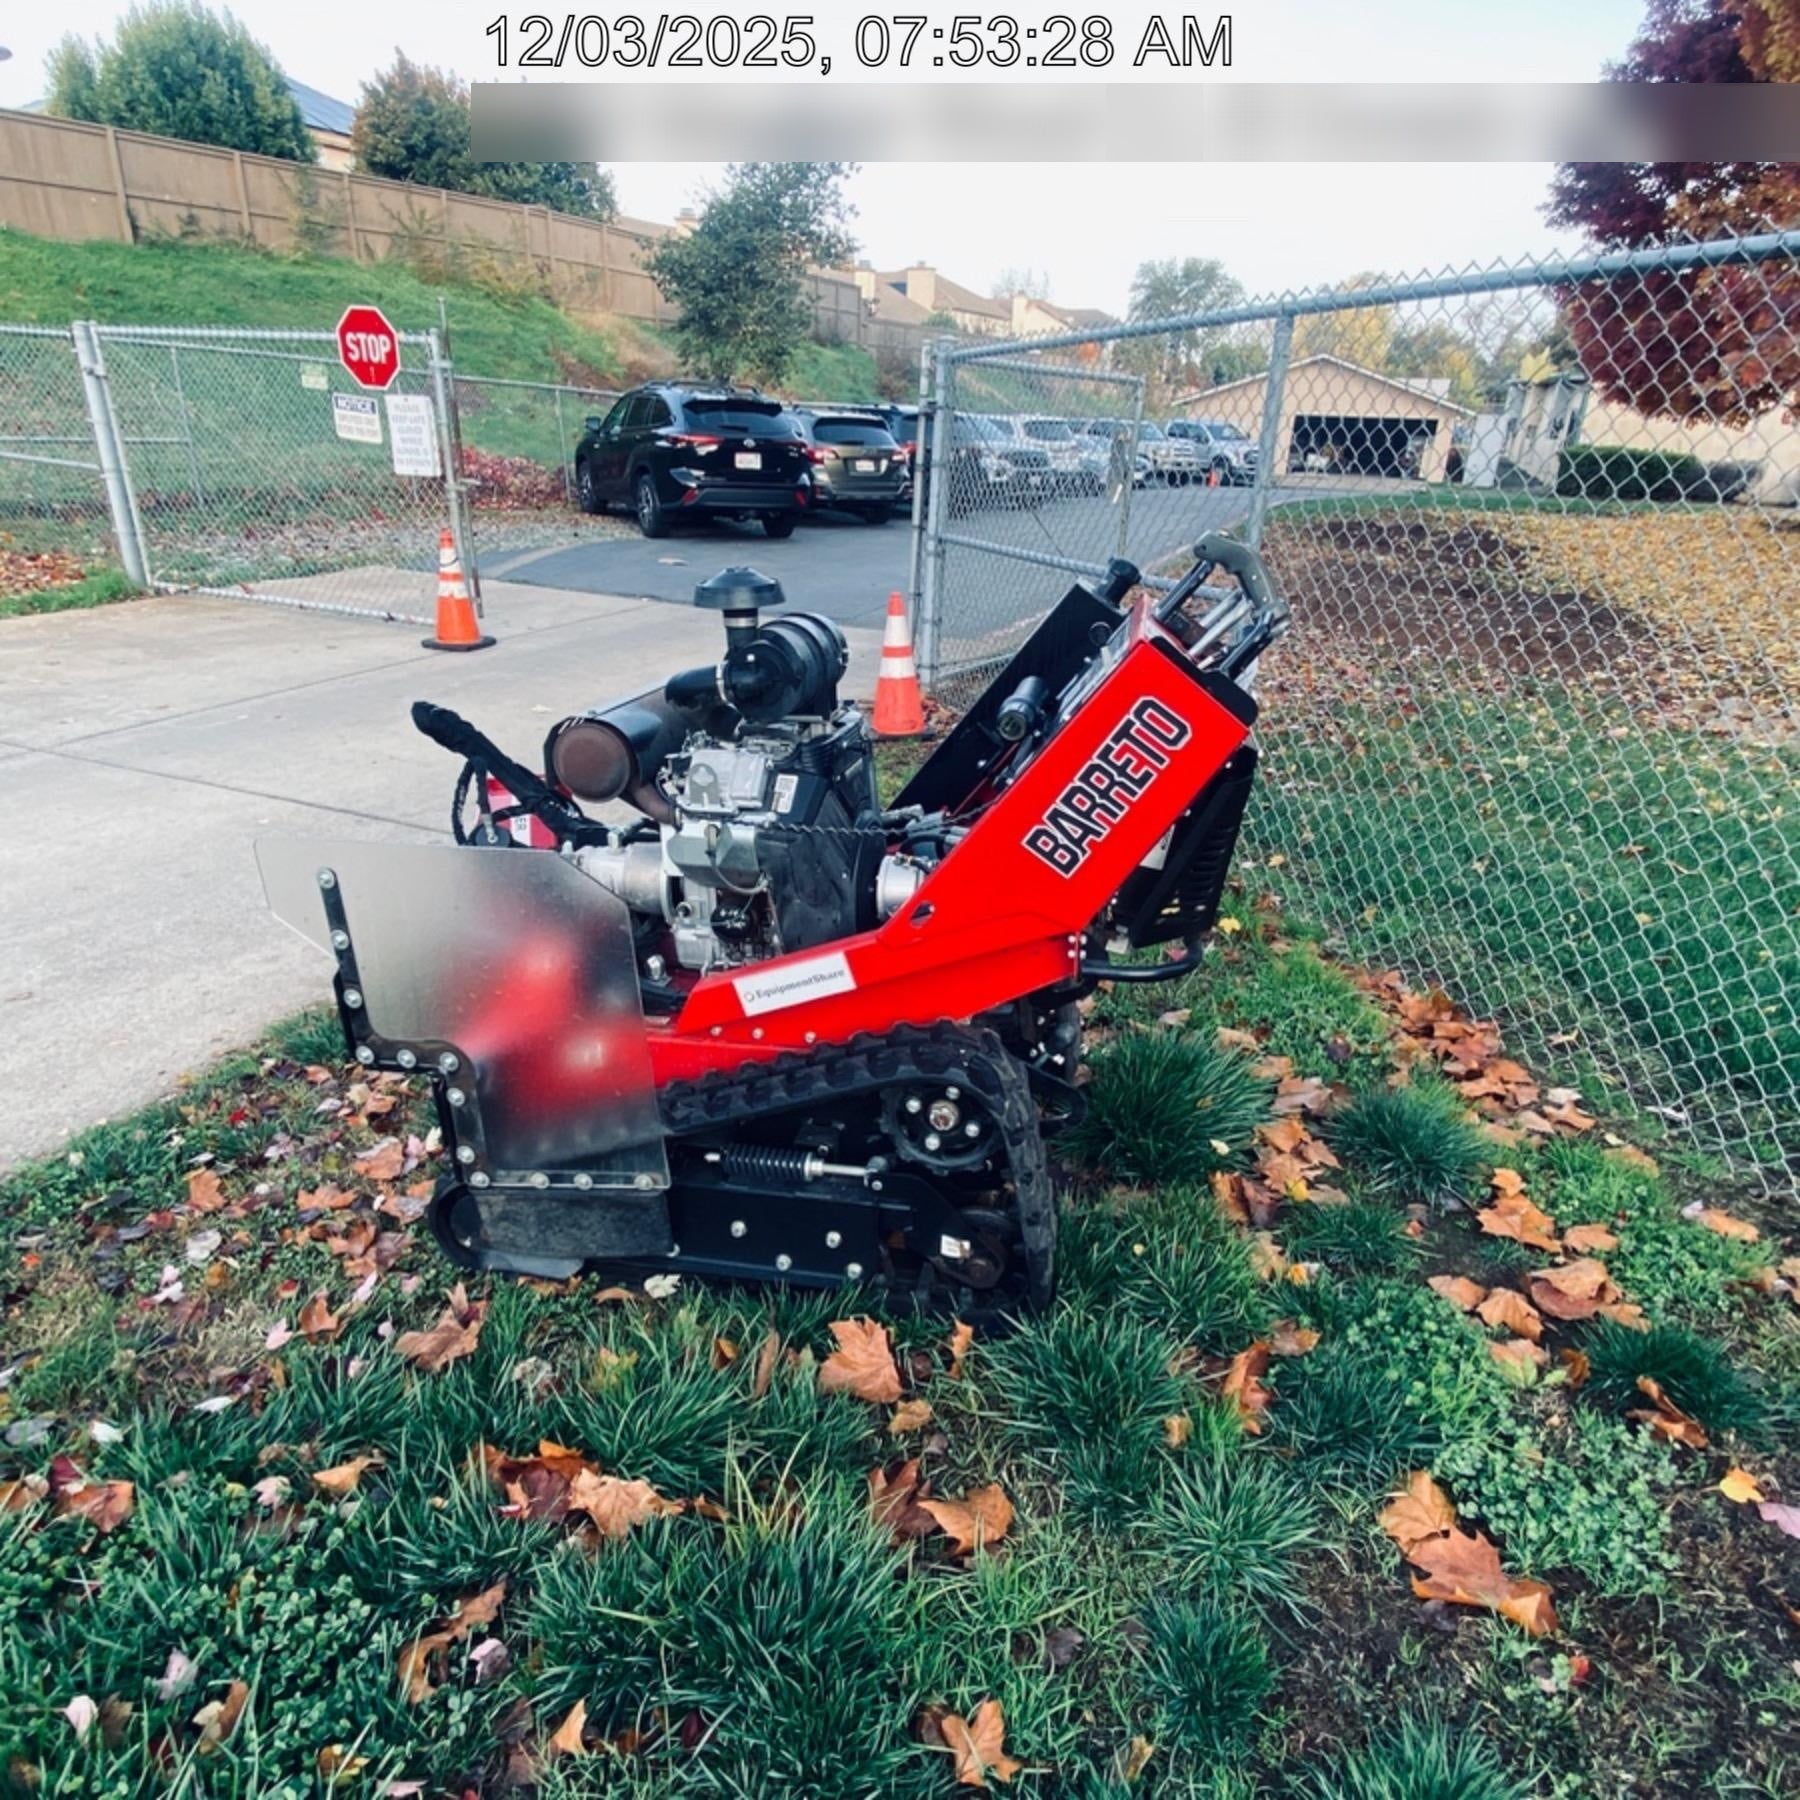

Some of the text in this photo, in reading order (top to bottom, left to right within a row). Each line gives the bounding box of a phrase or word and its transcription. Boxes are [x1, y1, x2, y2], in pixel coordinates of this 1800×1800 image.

[345, 332, 391, 364] STOP
[1021, 696, 1192, 879] BARRETO
[755, 970, 844, 998] EquipmentShare
